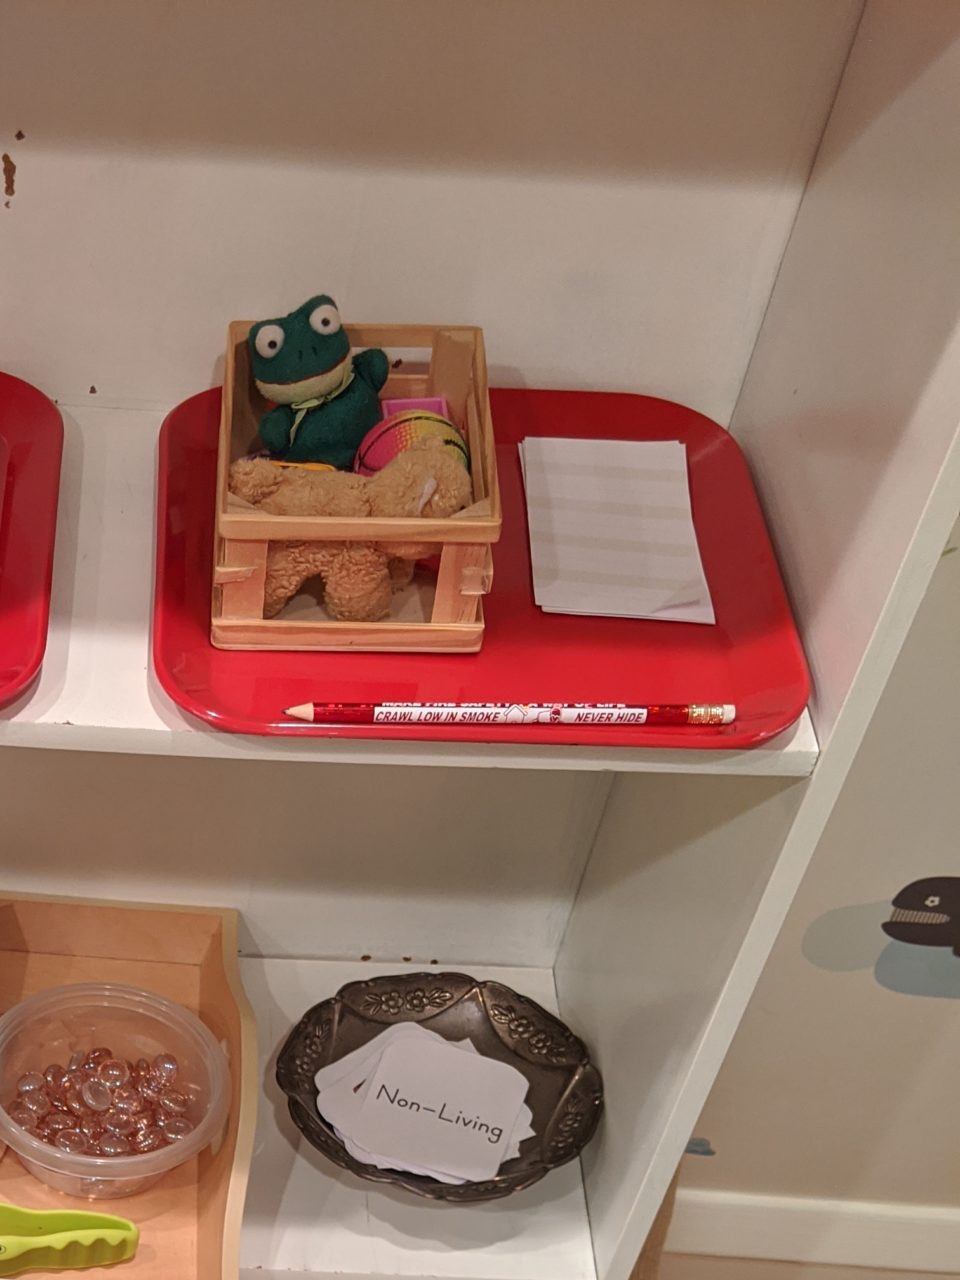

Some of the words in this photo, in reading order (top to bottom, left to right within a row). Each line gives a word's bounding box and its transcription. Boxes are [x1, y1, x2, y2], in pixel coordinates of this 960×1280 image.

[375, 711, 414, 723] CRAWL
[417, 711, 443, 722] LOW
[444, 711, 458, 722] IN
[459, 711, 501, 723] SMOKE
[574, 712, 614, 723] NEVER
[614, 712, 644, 723] HIDE
[375, 1083, 504, 1144] Non-Living
